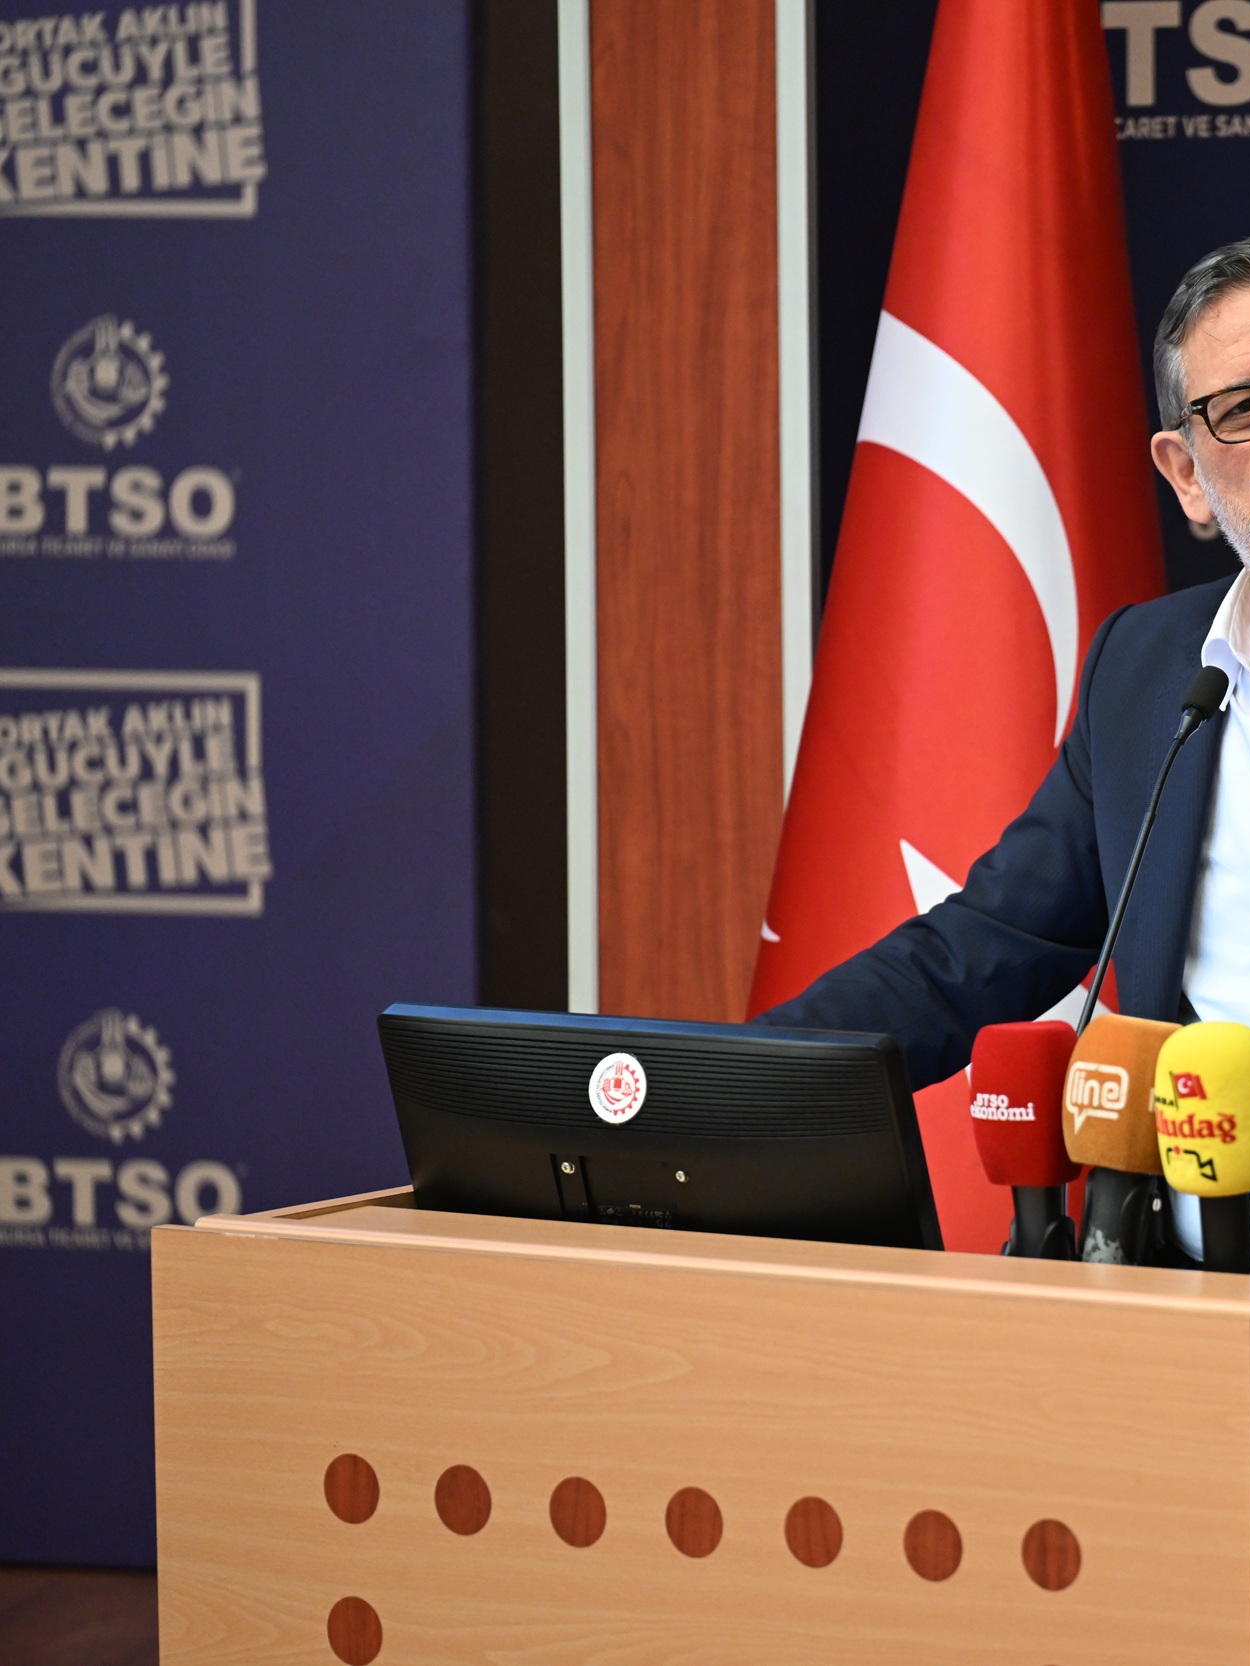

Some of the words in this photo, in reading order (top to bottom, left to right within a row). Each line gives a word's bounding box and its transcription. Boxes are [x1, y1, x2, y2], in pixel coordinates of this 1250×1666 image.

[1114, 116, 1177, 141] ARET
[1182, 115, 1211, 138] VE
[0, 464, 236, 540] BTSO
[1155, 1107, 1238, 1145] ludağ
[0, 1156, 242, 1226] BTSO
